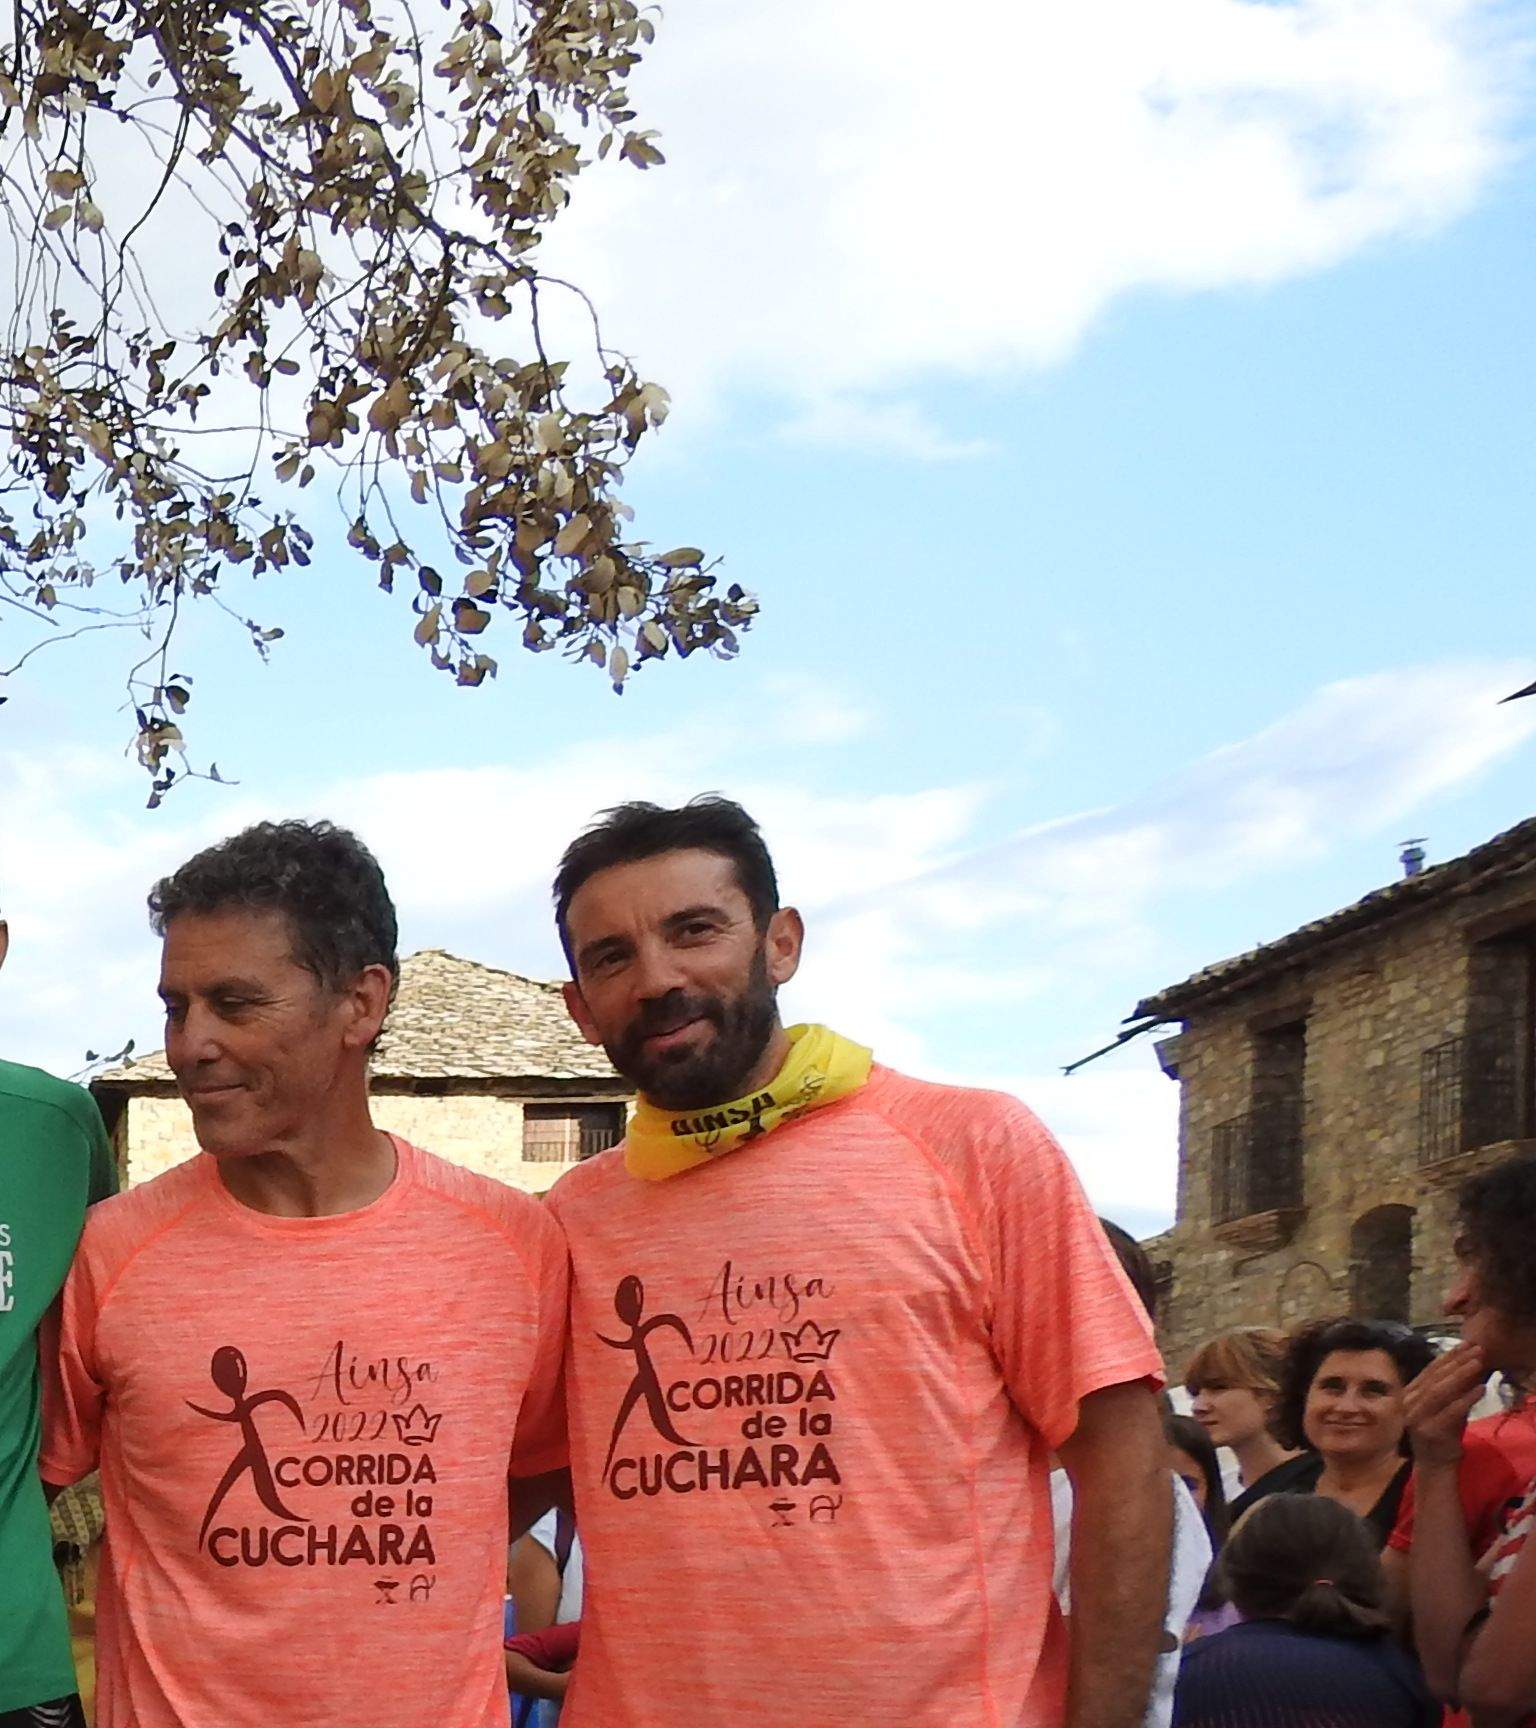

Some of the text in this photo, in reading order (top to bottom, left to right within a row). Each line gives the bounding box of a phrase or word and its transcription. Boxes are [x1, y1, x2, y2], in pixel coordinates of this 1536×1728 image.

[700, 1328, 774, 1365] 2022
[666, 1369, 835, 1412] CORRIDA
[311, 1410, 387, 1443] 2022
[741, 1407, 832, 1439] de la
[274, 1453, 437, 1487] CORRIDA
[610, 1442, 841, 1499] CUCHARA
[351, 1489, 433, 1518] de la
[207, 1524, 437, 1567] CUCHARA
